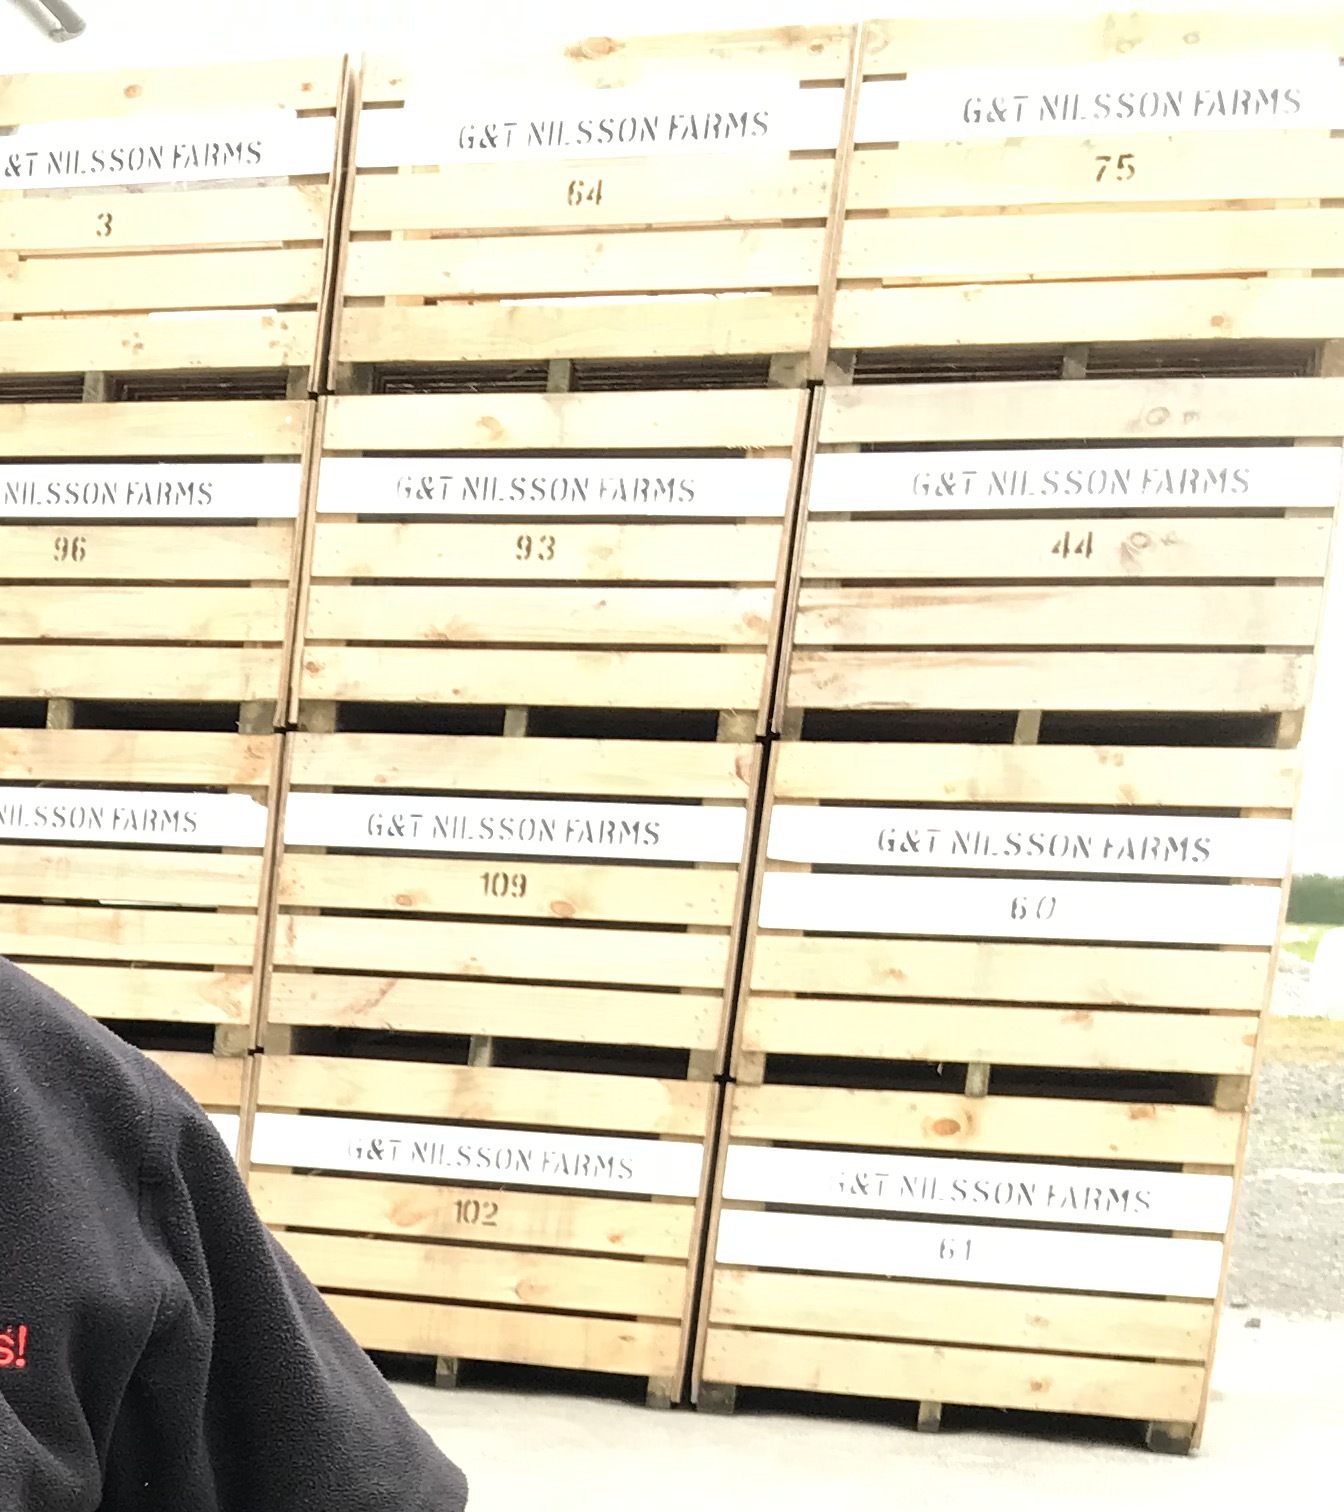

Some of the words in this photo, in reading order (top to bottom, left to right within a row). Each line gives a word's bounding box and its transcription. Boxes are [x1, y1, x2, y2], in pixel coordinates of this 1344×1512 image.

[963, 96, 1028, 123] G&T
[1040, 91, 1182, 121] NILSSON
[1194, 89, 1300, 116] FARMS
[459, 122, 517, 149] G&T
[528, 116, 658, 146] NILSSON
[669, 111, 768, 140] FARMS
[48, 145, 163, 174] NILSSON
[173, 141, 261, 167] FARMS
[1095, 153, 1135, 182] 75
[567, 179, 602, 206] 64
[96, 213, 113, 237] 3
[5, 482, 117, 505] NILSSON
[126, 482, 212, 505] FARMS
[397, 476, 453, 500] G&T
[462, 476, 588, 502] NILSSON
[600, 478, 694, 502] FARMS
[913, 471, 977, 496] G&T
[988, 469, 1130, 496] NILSSON
[1142, 468, 1249, 494] FARMS
[54, 536, 87, 562] 96
[516, 535, 555, 561] 93
[1051, 531, 1093, 559] 44
[113, 808, 197, 832] FARMS
[368, 813, 423, 837] G&T
[433, 815, 555, 842] NILSSON
[566, 819, 659, 845] FARMS
[878, 828, 941, 853] G&T
[952, 830, 1091, 858] NILSSON
[1103, 836, 1210, 862] FARMS
[480, 872, 527, 898] 109
[1011, 896, 1056, 920] 60
[412, 1142, 531, 1171] NILSSON
[542, 1151, 632, 1179] FARMS
[900, 1176, 1035, 1206] NILSSON
[1047, 1185, 1150, 1213] FARMS
[454, 1199, 498, 1227] 102
[940, 1239, 971, 1260] 61
